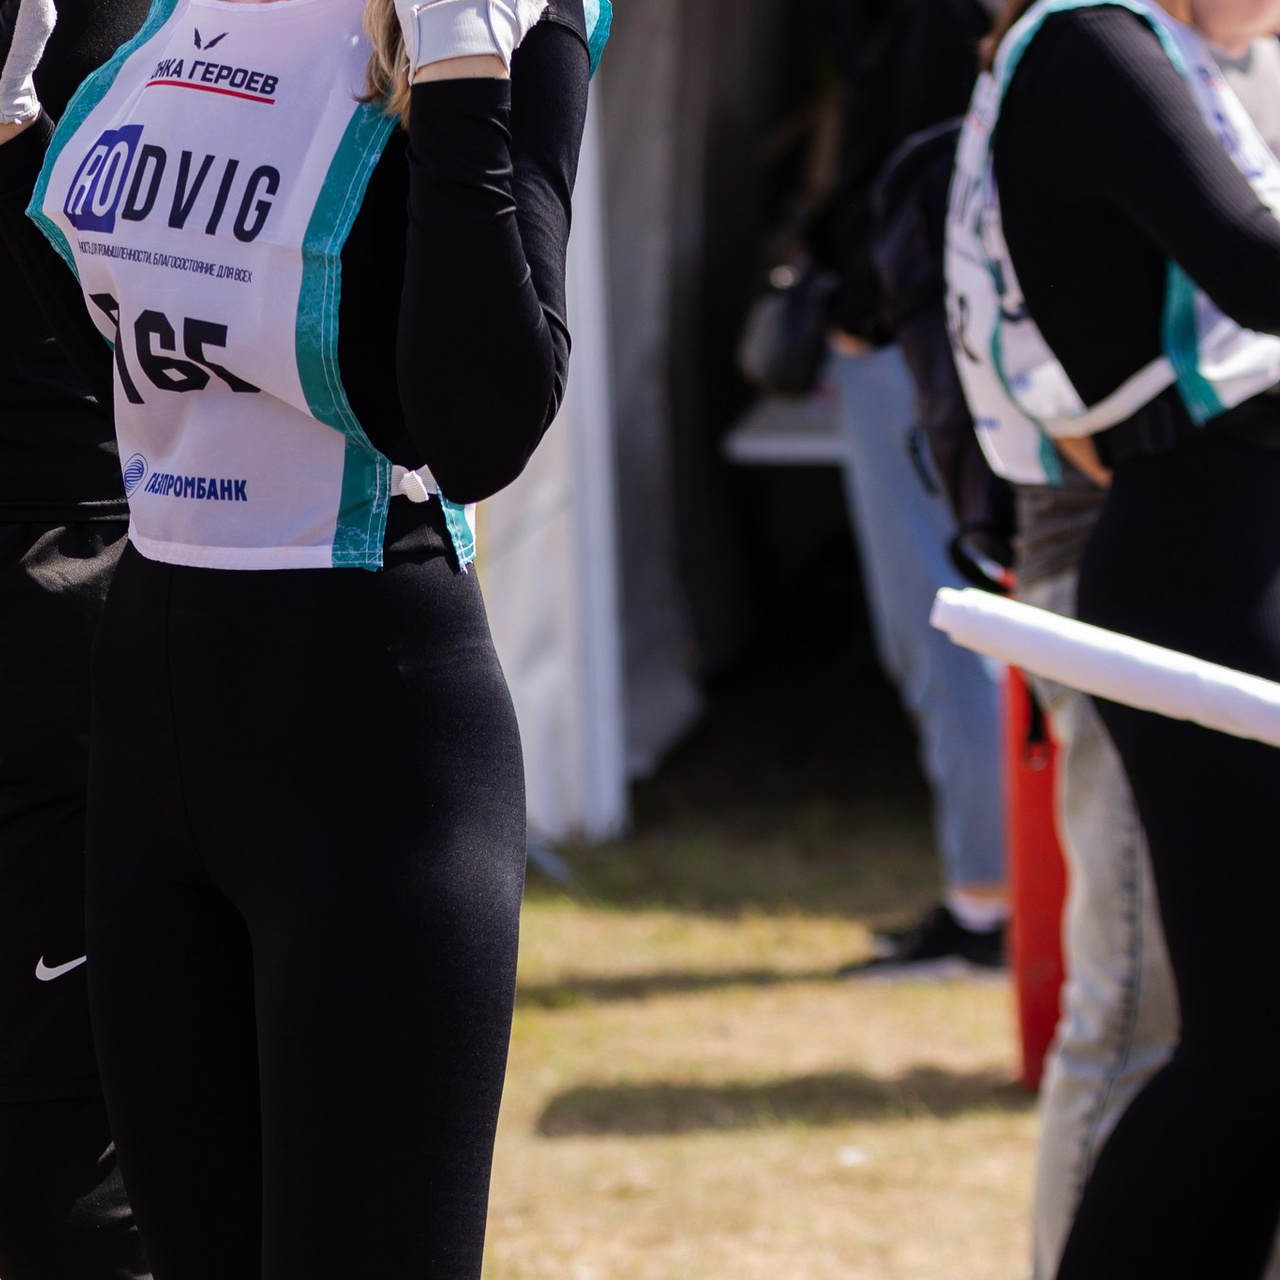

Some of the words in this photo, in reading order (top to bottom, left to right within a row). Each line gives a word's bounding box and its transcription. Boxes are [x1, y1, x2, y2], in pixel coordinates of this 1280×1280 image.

[188, 61, 279, 95] ГЕРОЕВ
[67, 140, 281, 243] RODVIG
[153, 253, 216, 277] БЛАГОСОСТОЯНИЕ
[216, 265, 234, 280] ДЛЯ
[234, 267, 253, 284] ВСЕХ
[144, 472, 248, 502] ГАЗПРОМБАНК
